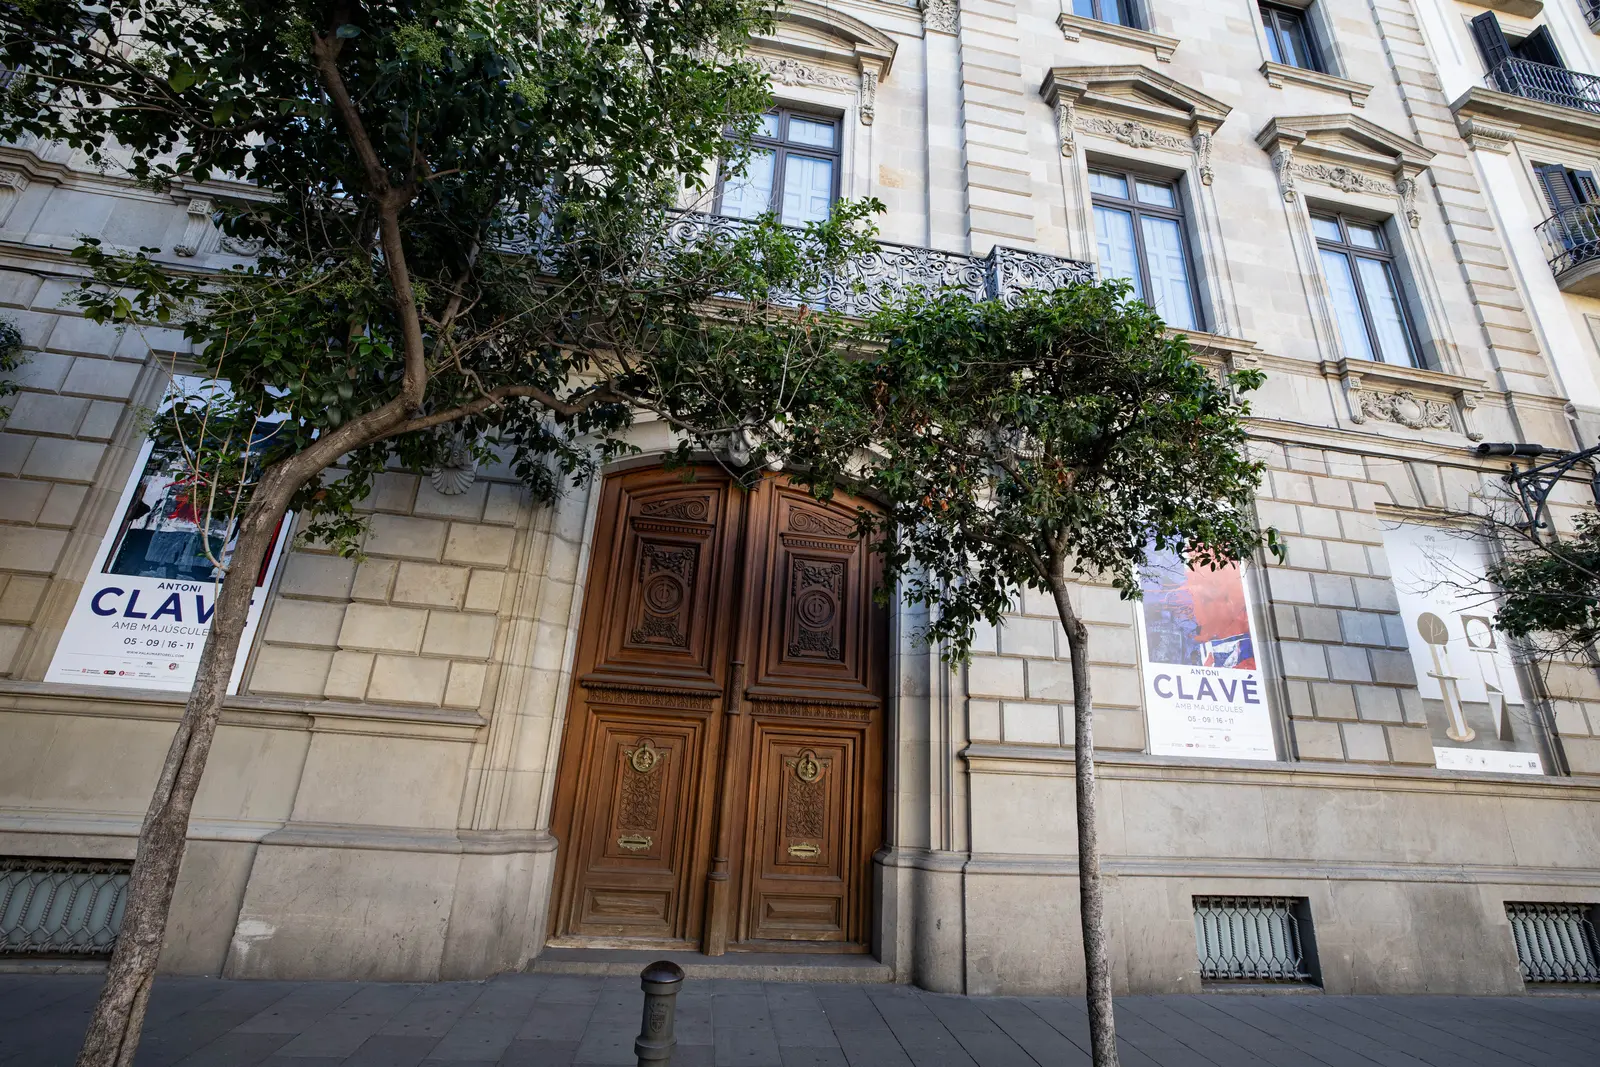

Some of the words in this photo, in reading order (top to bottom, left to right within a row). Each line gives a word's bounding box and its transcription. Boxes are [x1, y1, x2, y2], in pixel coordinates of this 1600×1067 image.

[157, 582, 202, 593] ANTONI
[90, 587, 254, 627] CLAV
[111, 621, 138, 631] AMB
[141, 622, 212, 637] MAJÚSCULE
[123, 637, 137, 645] 05
[146, 639, 160, 647] 09
[167, 640, 177, 649] 16
[186, 642, 194, 650] 11
[1190, 668, 1219, 676] ANTONI
[1153, 673, 1260, 704] CLAVÉ
[1175, 702, 1192, 710] AMB
